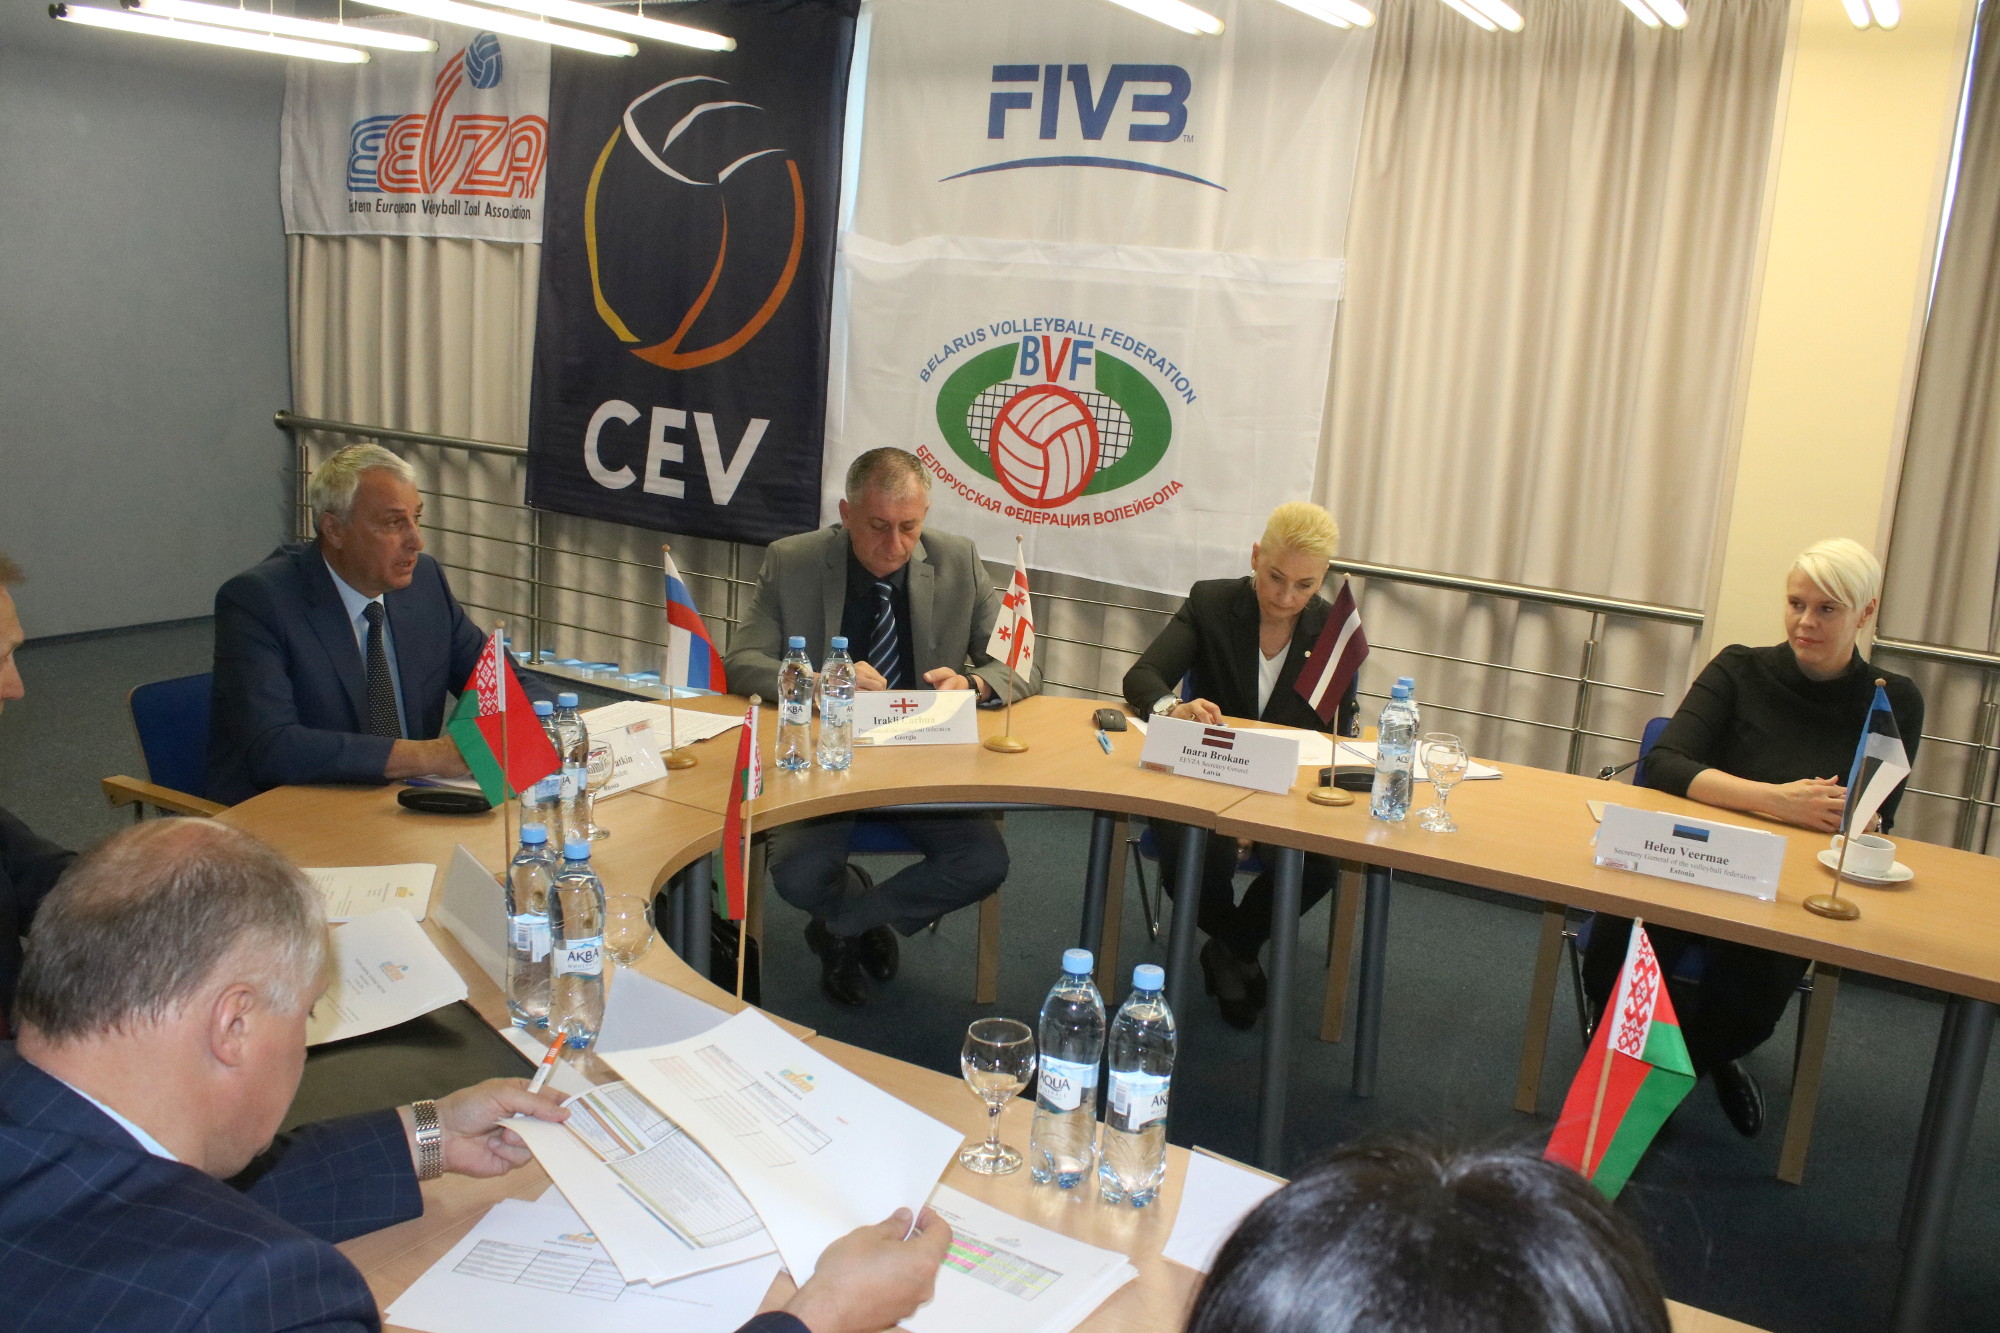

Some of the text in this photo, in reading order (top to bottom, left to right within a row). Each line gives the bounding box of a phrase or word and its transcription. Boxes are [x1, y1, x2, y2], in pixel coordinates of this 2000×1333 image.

[987, 64, 1192, 143] FIVB
[1183, 134, 1194, 143] TM
[919, 317, 1197, 406] BELARUS VOLLEYBALL FEDERATION
[1019, 335, 1094, 383] BVF
[584, 400, 771, 506] CEV
[915, 444, 1184, 528] БЕЛОРУССКАЯ ФЕДЕРАЦИЯ ВОЛЕЙБОЛА
[873, 716, 899, 725] Irakli
[615, 755, 634, 767] atkin
[1182, 745, 1250, 766] Inara Brokane
[1202, 760, 1226, 771] Secretary
[1226, 765, 1249, 774] General
[1202, 768, 1221, 777] Latvia
[1613, 847, 1757, 881] Secretary General of the volleyball federation
[1644, 840, 1730, 866] Helen Veermae
[1669, 866, 1695, 878] Estonia
[1039, 1070, 1070, 1092] AQUA
